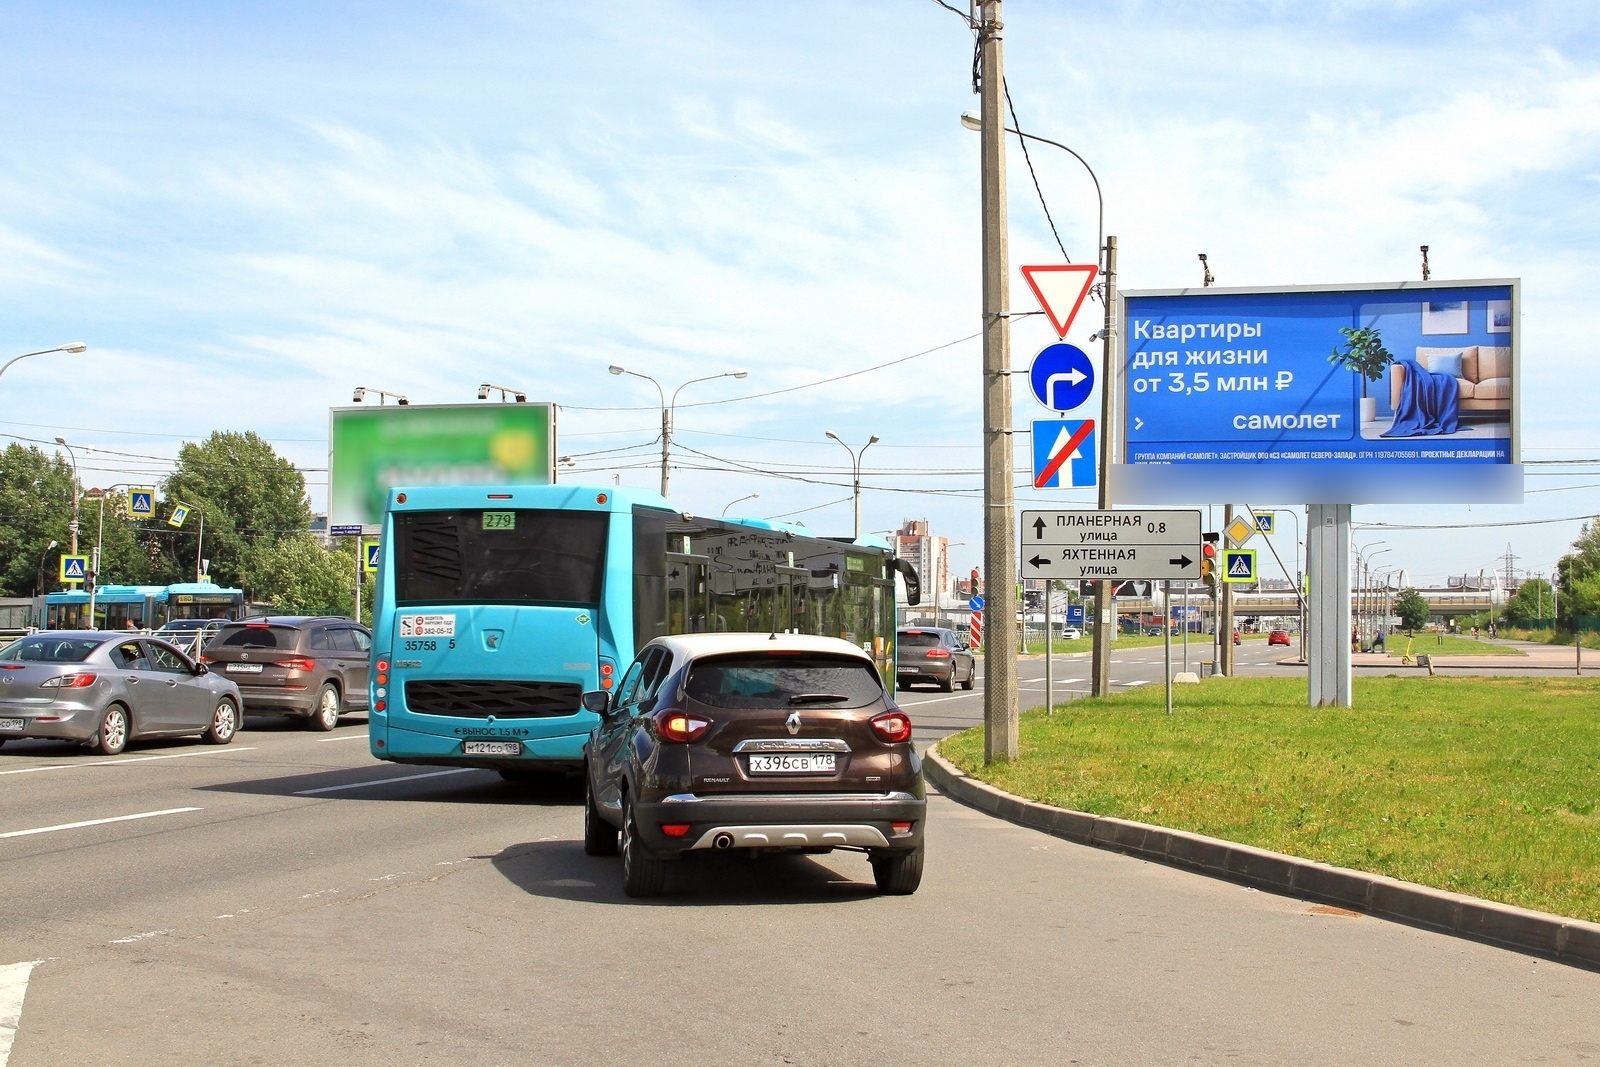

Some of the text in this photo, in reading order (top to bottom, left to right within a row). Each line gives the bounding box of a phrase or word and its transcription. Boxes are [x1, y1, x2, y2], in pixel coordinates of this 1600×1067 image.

[1134, 320, 1262, 344] Квартиры
[1132, 349, 1268, 370] для жизни
[1133, 377, 1162, 393] от
[1168, 372, 1210, 396] 3,5
[1217, 376, 1268, 391] млн
[1233, 414, 1341, 430] самолет
[1156, 452, 1186, 460] КОМПАНИЙ
[1220, 451, 1257, 460] ЗАСТРОЙЩИК
[1358, 451, 1374, 459] ОГРН
[1420, 450, 1456, 458] ПРОЕКТНЫЕ
[1456, 450, 1496, 459] ДЕКЛАРАЦИИ
[1496, 450, 1505, 458] НА
[487, 514, 511, 527] 279
[1056, 515, 1142, 527] ПЛАНЕРНАЯ
[1080, 532, 1117, 543] улица
[1062, 549, 1136, 560] ЯХТЕННАЯ
[1080, 566, 1117, 575] улица
[405, 641, 436, 650] 35758
[449, 639, 455, 649] 5
[754, 754, 833, 770] Х396СВ 178
